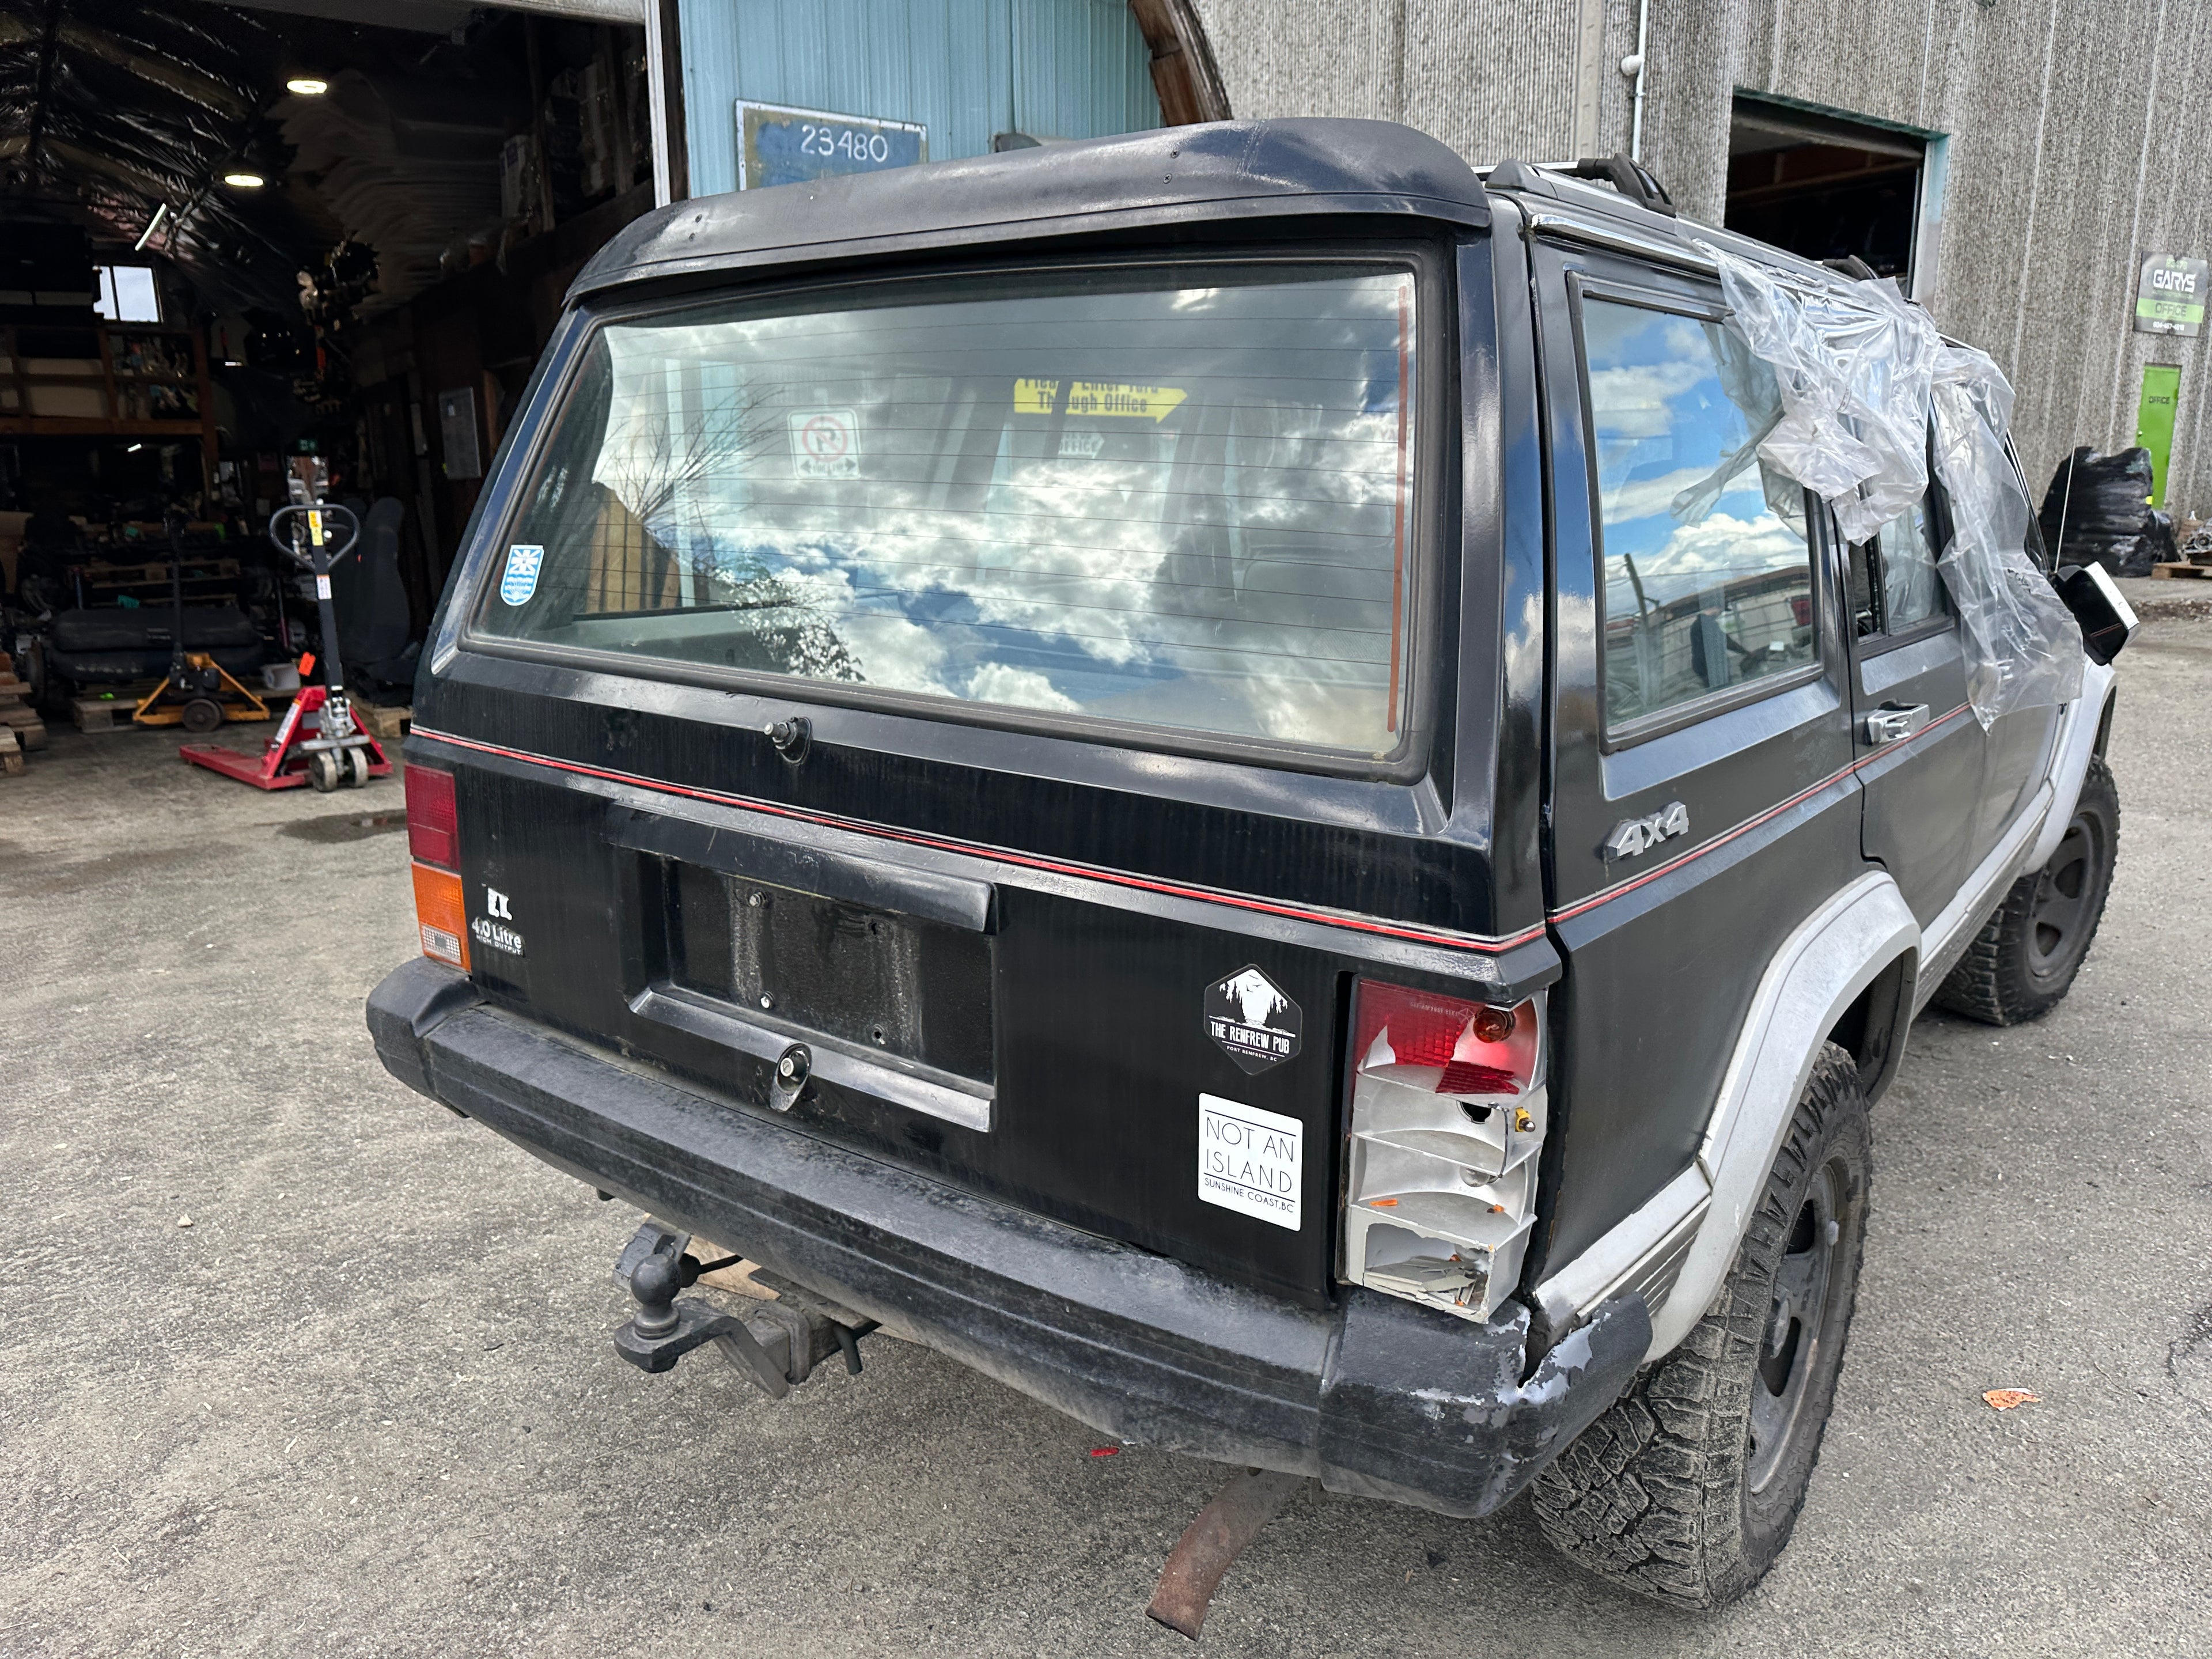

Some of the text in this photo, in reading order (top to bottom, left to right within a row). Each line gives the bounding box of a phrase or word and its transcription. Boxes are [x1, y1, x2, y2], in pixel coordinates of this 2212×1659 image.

[801, 124, 888, 162] 23480
[2153, 269, 2196, 293] GARYS
[2156, 302, 2187, 317] OFFICE
[1037, 391, 1146, 413] Thugh Office
[2148, 396, 2170, 404] OFFICE
[472, 916, 522, 949] 4.0 Litre
[476, 934, 521, 956] HIGH OUTPUT
[1210, 1021, 1290, 1054] THE RENFREW PUB
[1207, 1116, 1294, 1162] NOT AN
[1207, 1148, 1292, 1192] ISLAND
[1205, 1177, 1244, 1197] SUNSHINE
